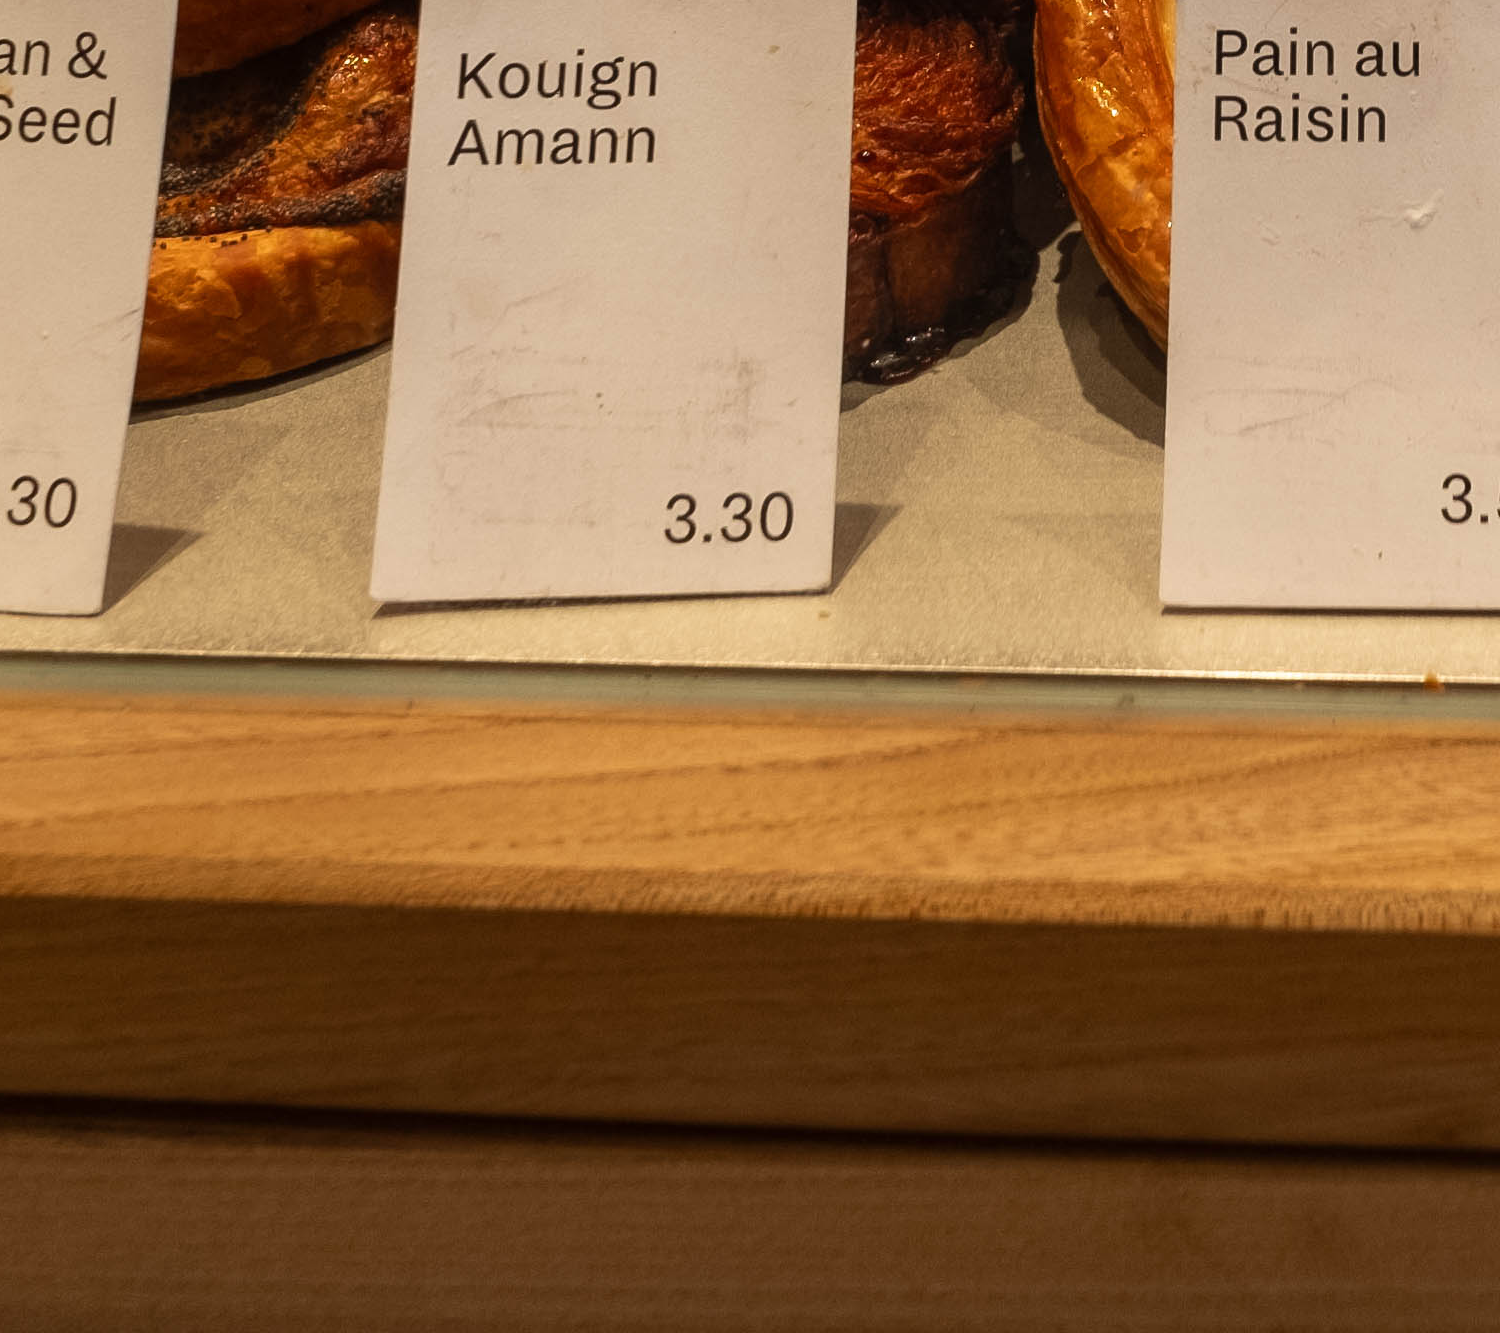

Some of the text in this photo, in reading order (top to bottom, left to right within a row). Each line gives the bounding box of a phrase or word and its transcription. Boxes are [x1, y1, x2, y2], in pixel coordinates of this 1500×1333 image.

[67, 31, 108, 80] &
[1215, 26, 1420, 78] Pain au
[457, 48, 658, 111] Kouign
[447, 119, 656, 167] Amann
[1214, 92, 1386, 143] Raisin
[664, 491, 794, 545] 3.30
